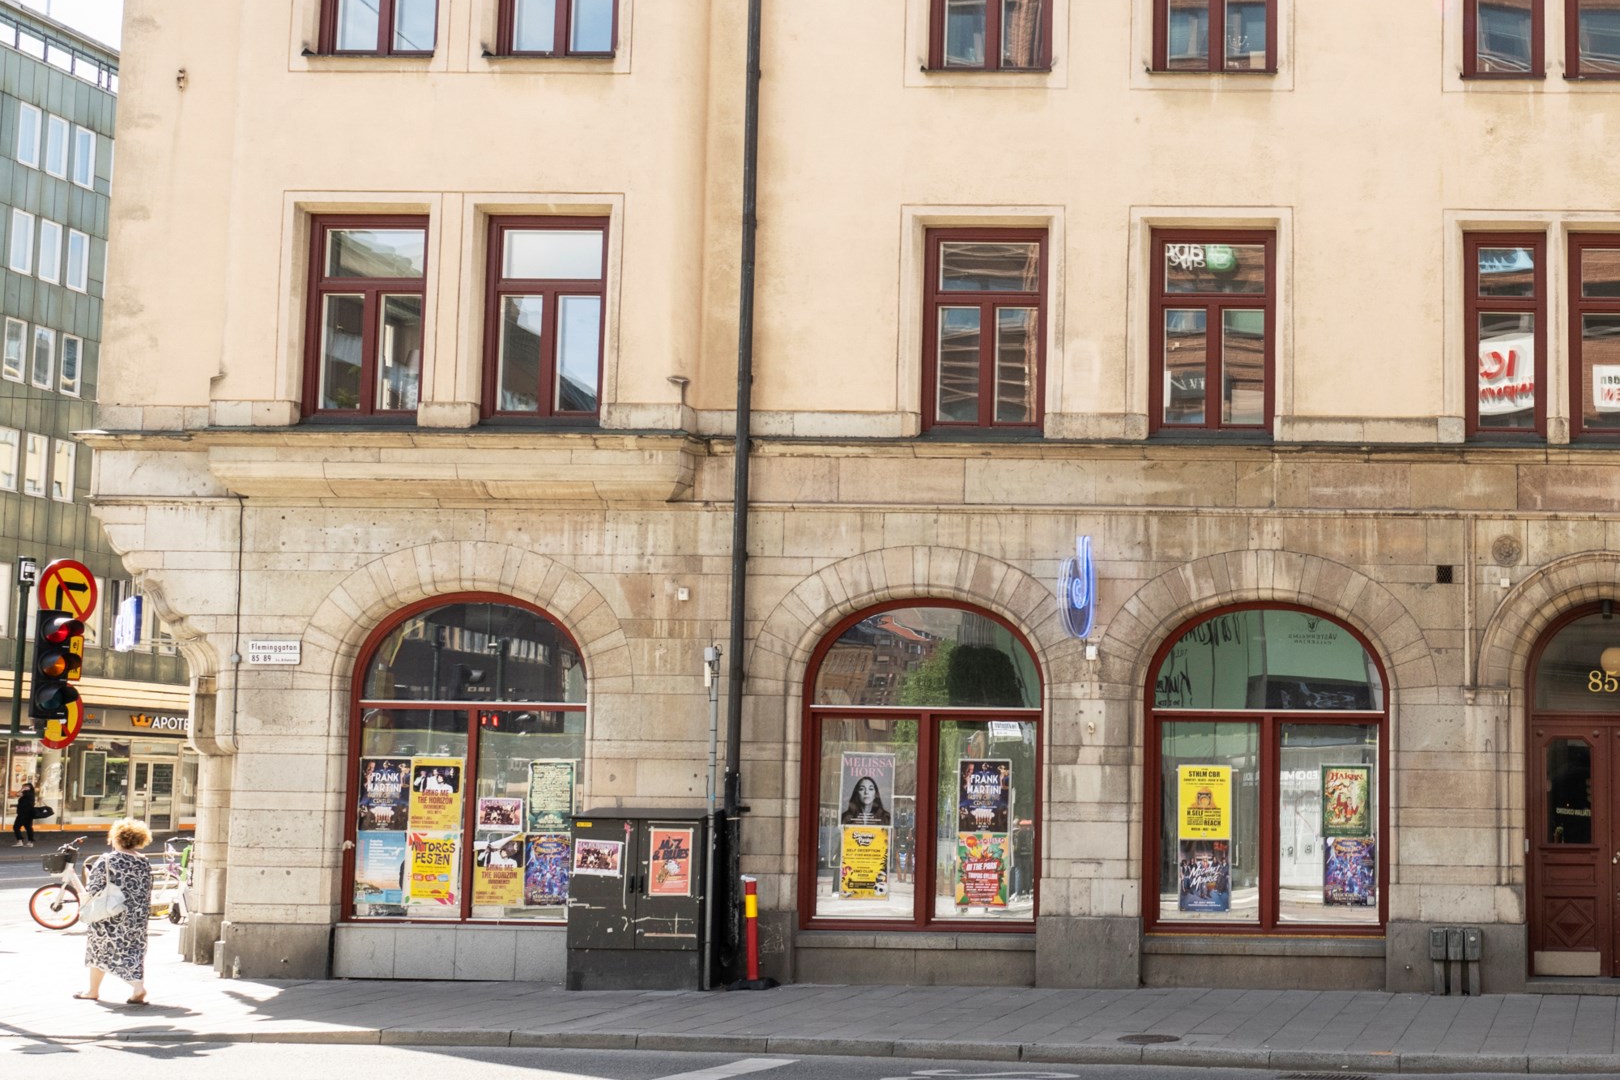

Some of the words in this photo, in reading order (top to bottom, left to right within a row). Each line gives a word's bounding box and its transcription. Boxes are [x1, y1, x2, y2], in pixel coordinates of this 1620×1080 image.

[251, 643, 298, 652] Fleminggatan
[1588, 670, 1619, 692] 85
[844, 758, 894, 768] MELISSA
[371, 772, 399, 782] FRANK
[850, 768, 884, 776] HORN
[970, 774, 998, 784] FRANK
[366, 782, 402, 792] MARTINI
[967, 785, 1002, 794] MARTINI
[415, 853, 450, 865] FESTEN
[653, 851, 660, 860] &
[662, 848, 689, 860] BLUES
